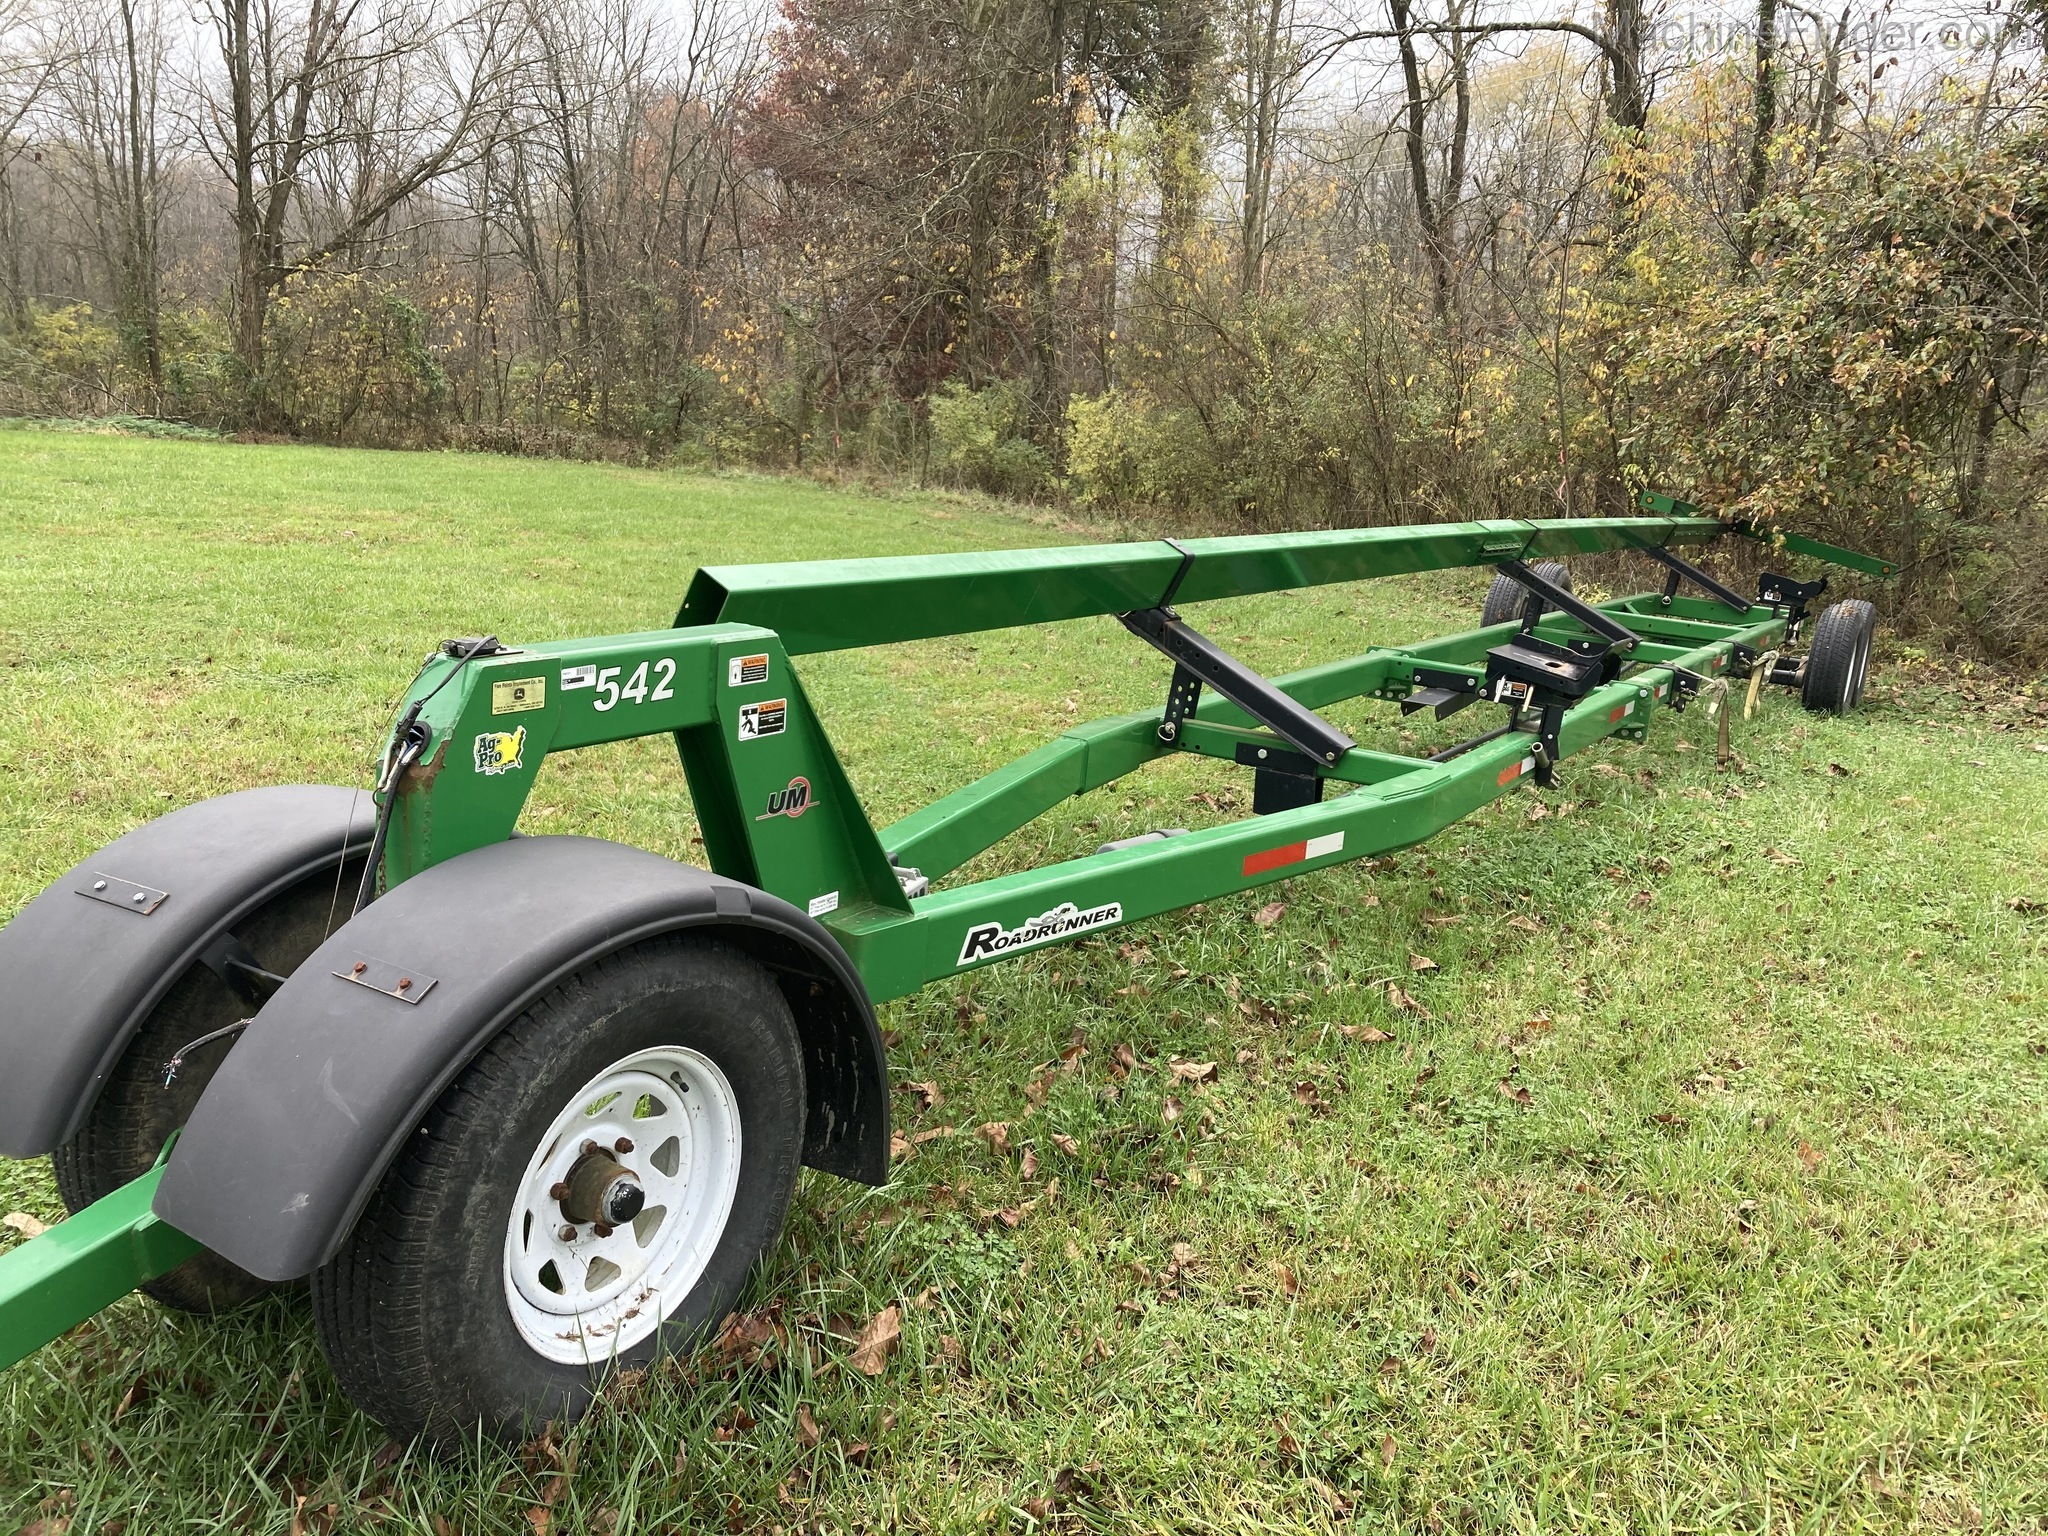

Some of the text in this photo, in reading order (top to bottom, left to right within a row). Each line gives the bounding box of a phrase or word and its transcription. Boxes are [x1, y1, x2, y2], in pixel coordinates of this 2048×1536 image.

[748, 656, 767, 665] WARNING
[592, 657, 677, 712] 542
[765, 701, 784, 710] WARNING
[478, 736, 501, 753] Ag-
[478, 751, 503, 769] Pro
[767, 785, 807, 814] UM
[963, 907, 1119, 960] ROADRUNNER
[749, 1015, 793, 1118] RADIAL
